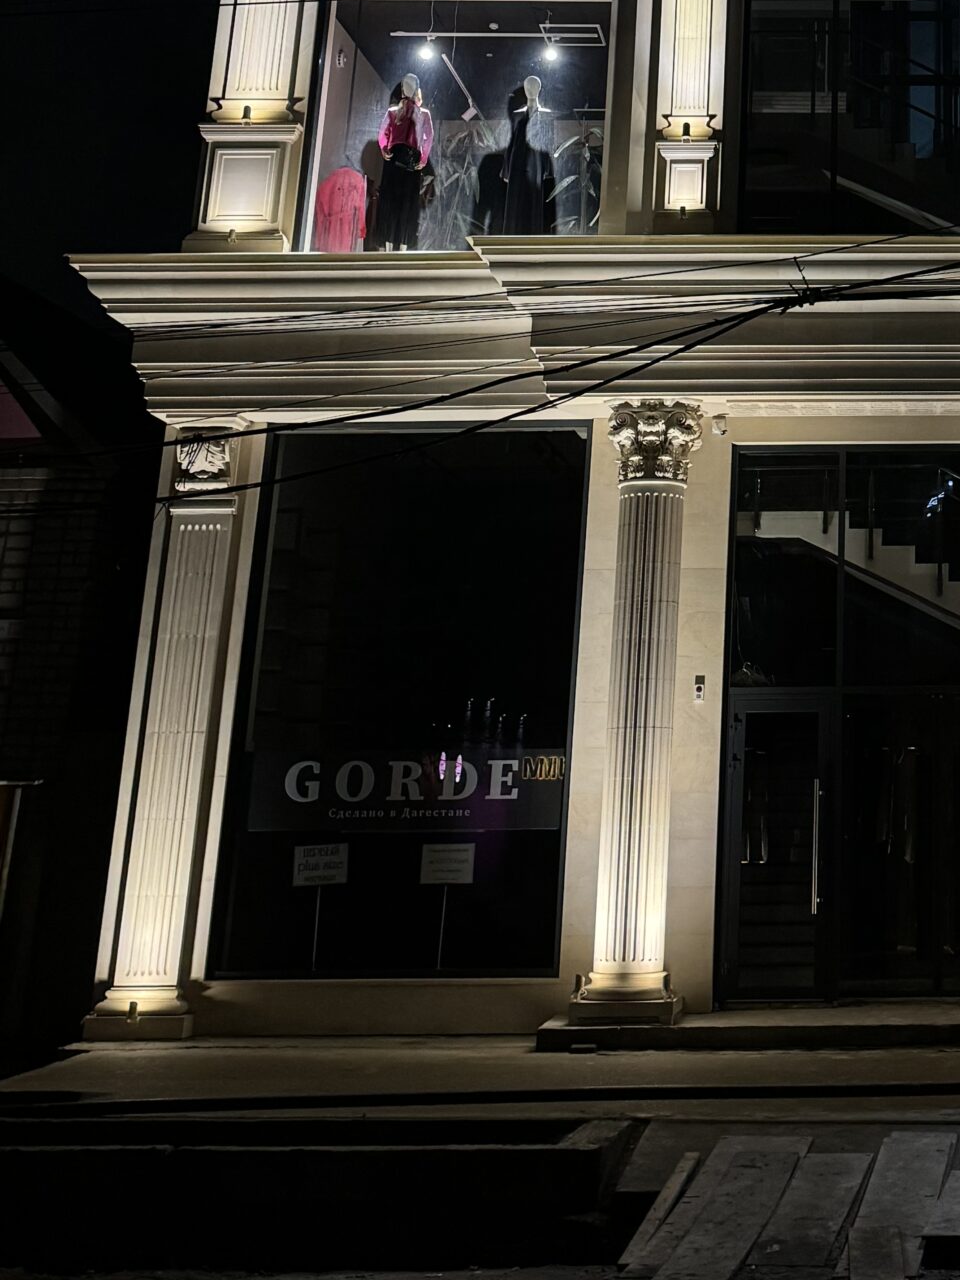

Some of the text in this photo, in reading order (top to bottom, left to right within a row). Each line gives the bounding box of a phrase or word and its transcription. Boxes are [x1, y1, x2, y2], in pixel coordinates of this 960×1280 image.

[284, 759, 519, 802] GORDE
[328, 807, 471, 819] Сделано в Дагестане
